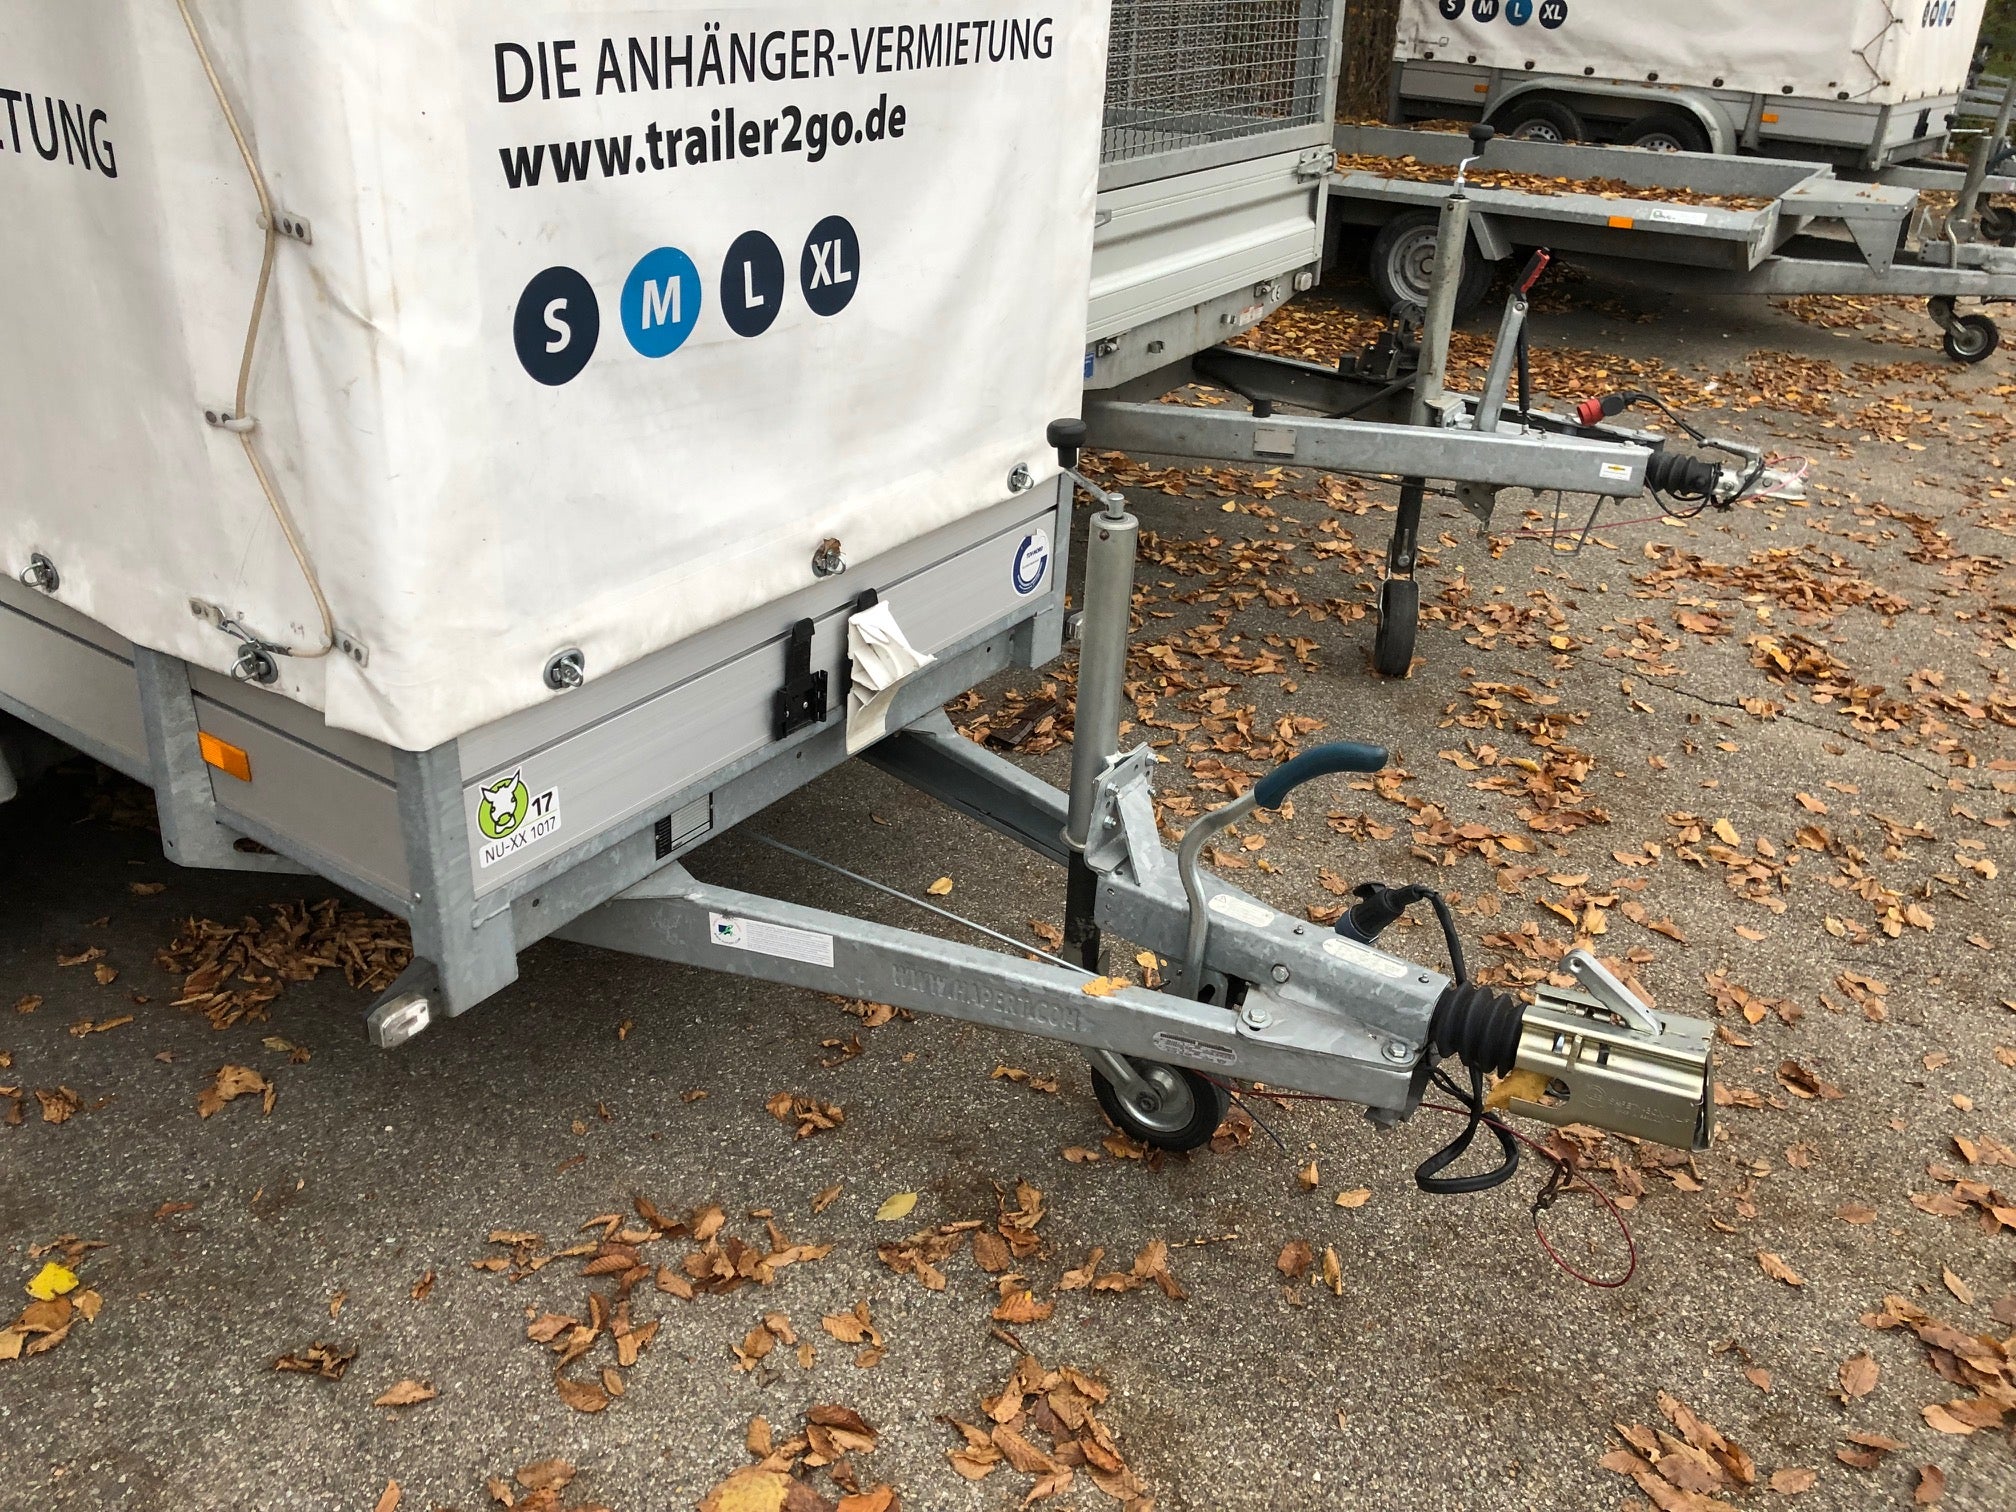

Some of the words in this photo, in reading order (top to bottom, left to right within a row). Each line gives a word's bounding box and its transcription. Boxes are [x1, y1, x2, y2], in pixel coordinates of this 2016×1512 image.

[1447, 0, 1456, 12] S
[1478, 1, 1493, 15] M
[1514, 3, 1523, 18] L
[1543, 4, 1563, 20] XL
[495, 40, 581, 103] DIE
[595, 18, 1053, 96] ANHÄNGER-VERMIETUNG
[0, 87, 118, 178] TUNG
[498, 93, 906, 189] www.trailer2go.de
[543, 298, 571, 353] S
[642, 275, 681, 330] M
[743, 261, 764, 308] L
[809, 238, 852, 290] XL
[485, 830, 527, 864] NU-XX
[531, 816, 556, 839] 1017
[531, 791, 553, 817] 17
